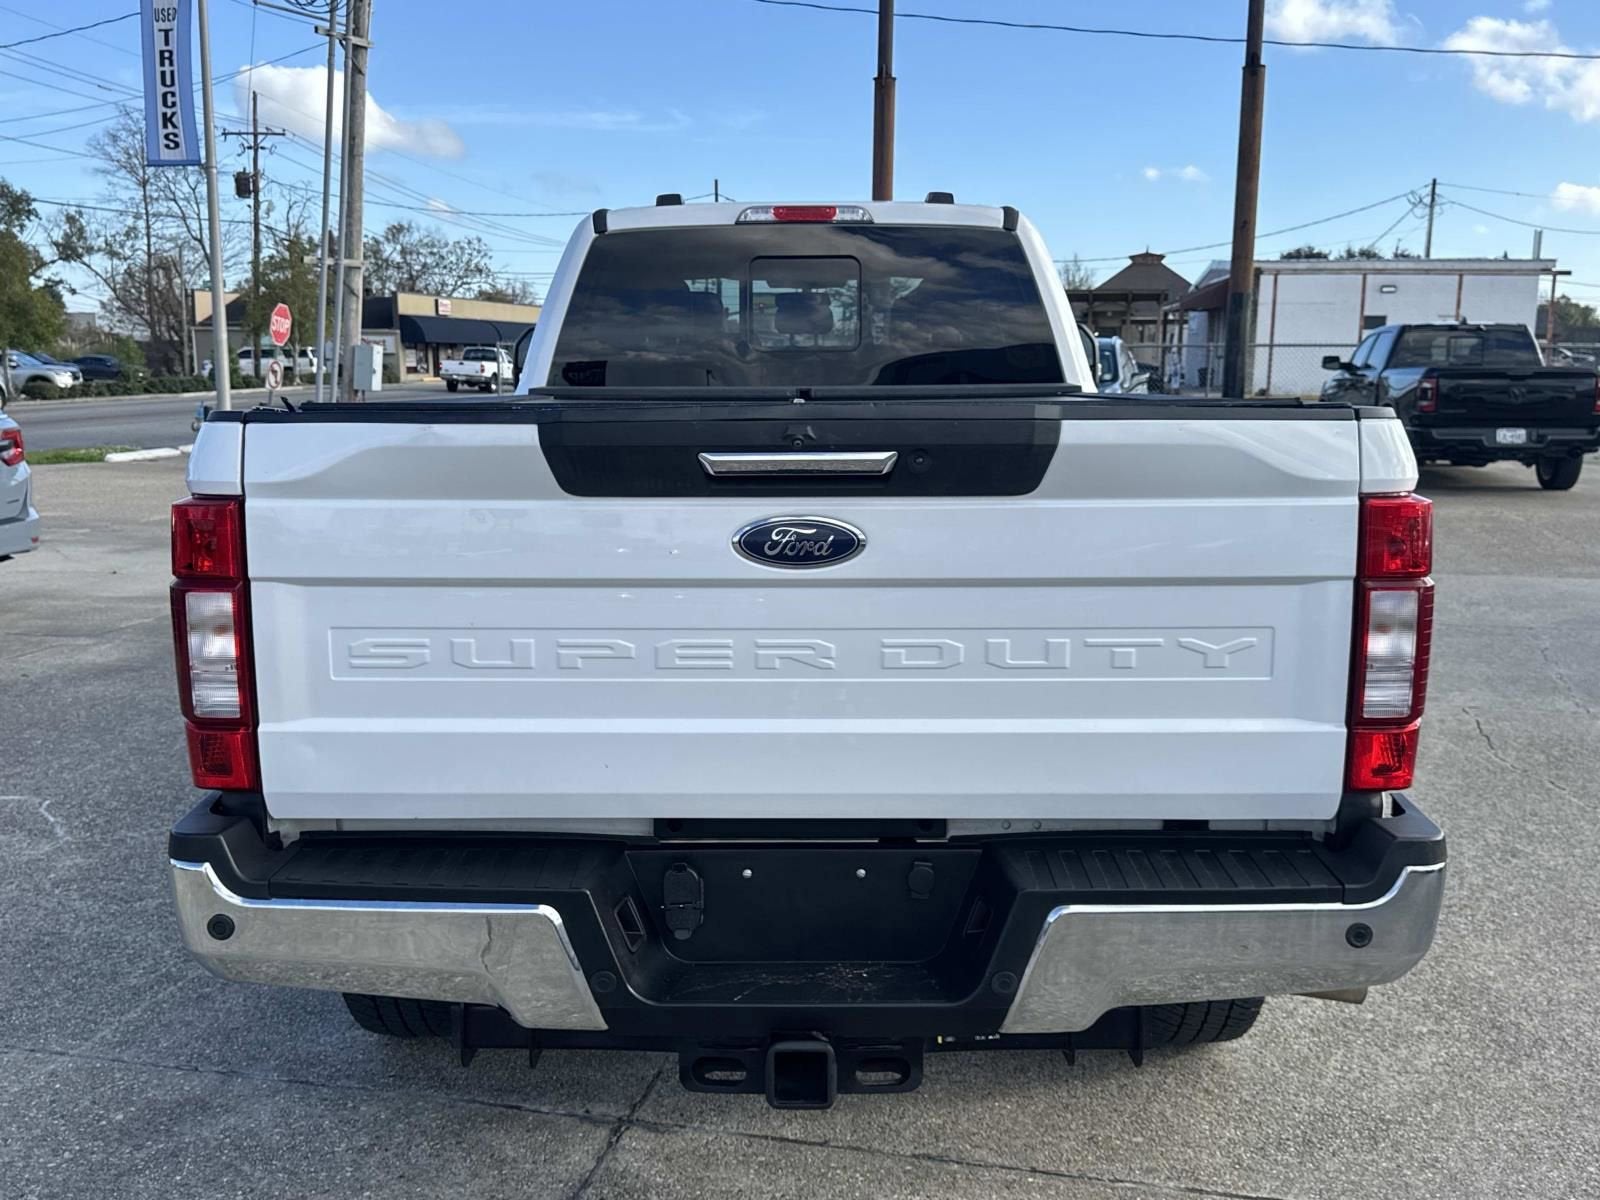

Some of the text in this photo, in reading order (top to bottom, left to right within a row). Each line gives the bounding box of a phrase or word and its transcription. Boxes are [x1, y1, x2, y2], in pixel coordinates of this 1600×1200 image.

[154, 8, 177, 23] USED
[158, 28, 180, 150] TRUCKS
[271, 315, 290, 333] STOP
[764, 526, 834, 556] Ford
[348, 638, 1257, 669] SUPER DUTY
